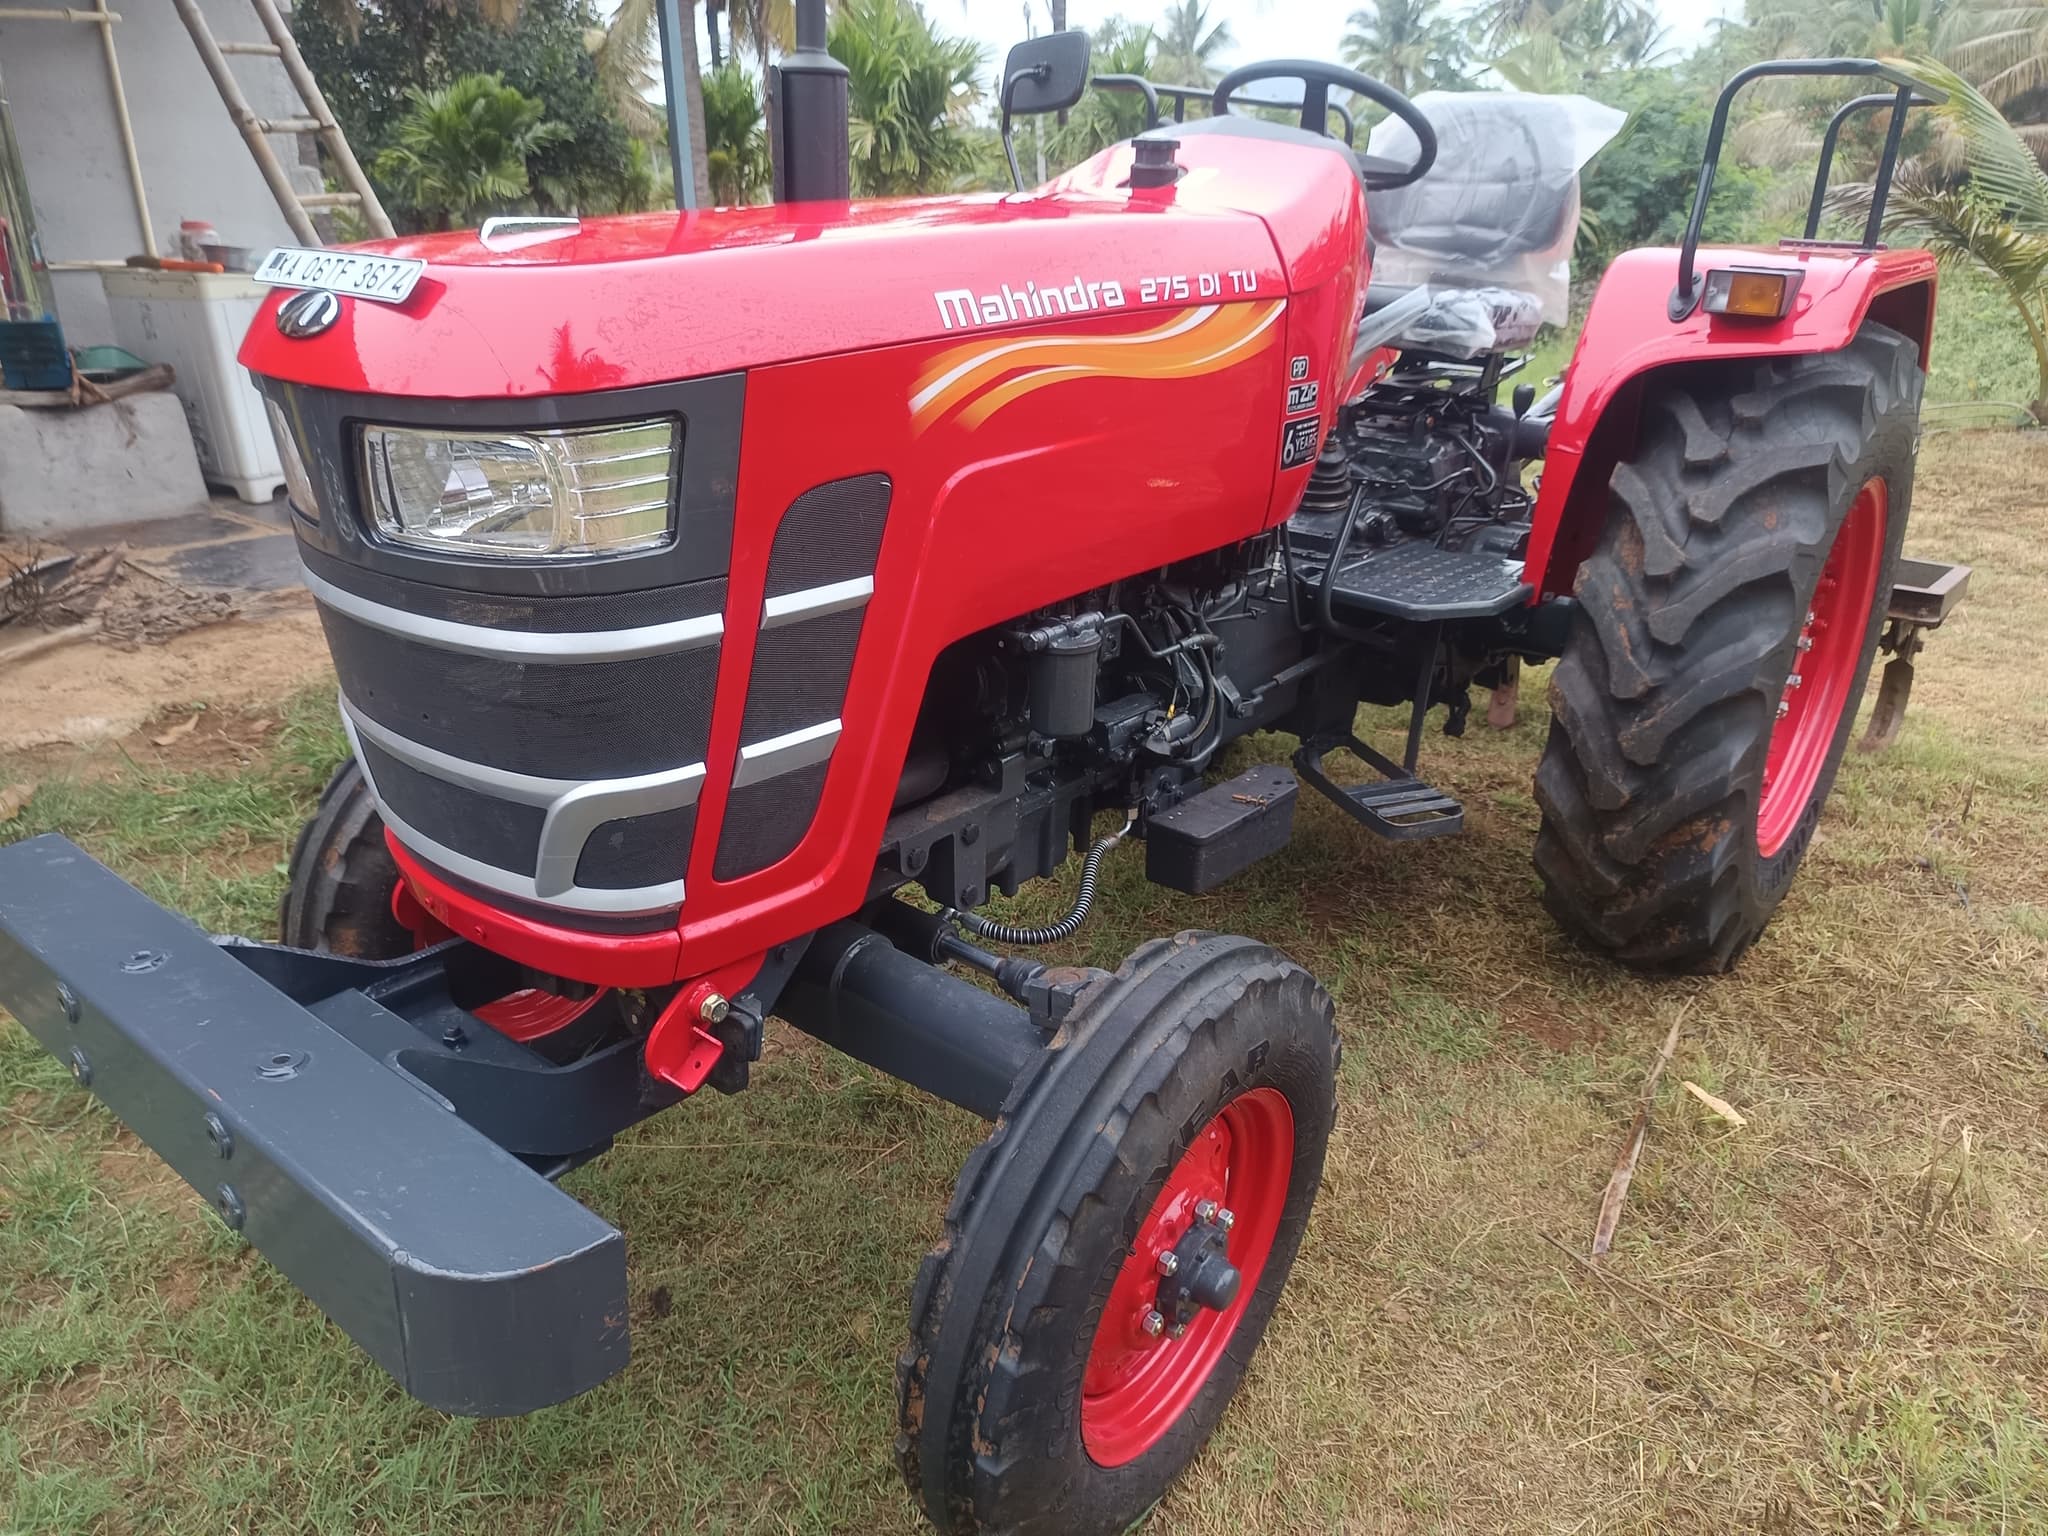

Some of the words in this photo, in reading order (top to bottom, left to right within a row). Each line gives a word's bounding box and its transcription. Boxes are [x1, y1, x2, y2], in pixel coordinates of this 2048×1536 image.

[274, 254, 302, 278] KA
[354, 262, 414, 294] 3674
[934, 276, 1125, 329] Mahindra
[1139, 275, 1190, 303] 275
[1198, 272, 1220, 297] DI
[1228, 270, 1257, 292] TU
[1283, 429, 1295, 464] 6
[1296, 433, 1318, 452] YEARS
